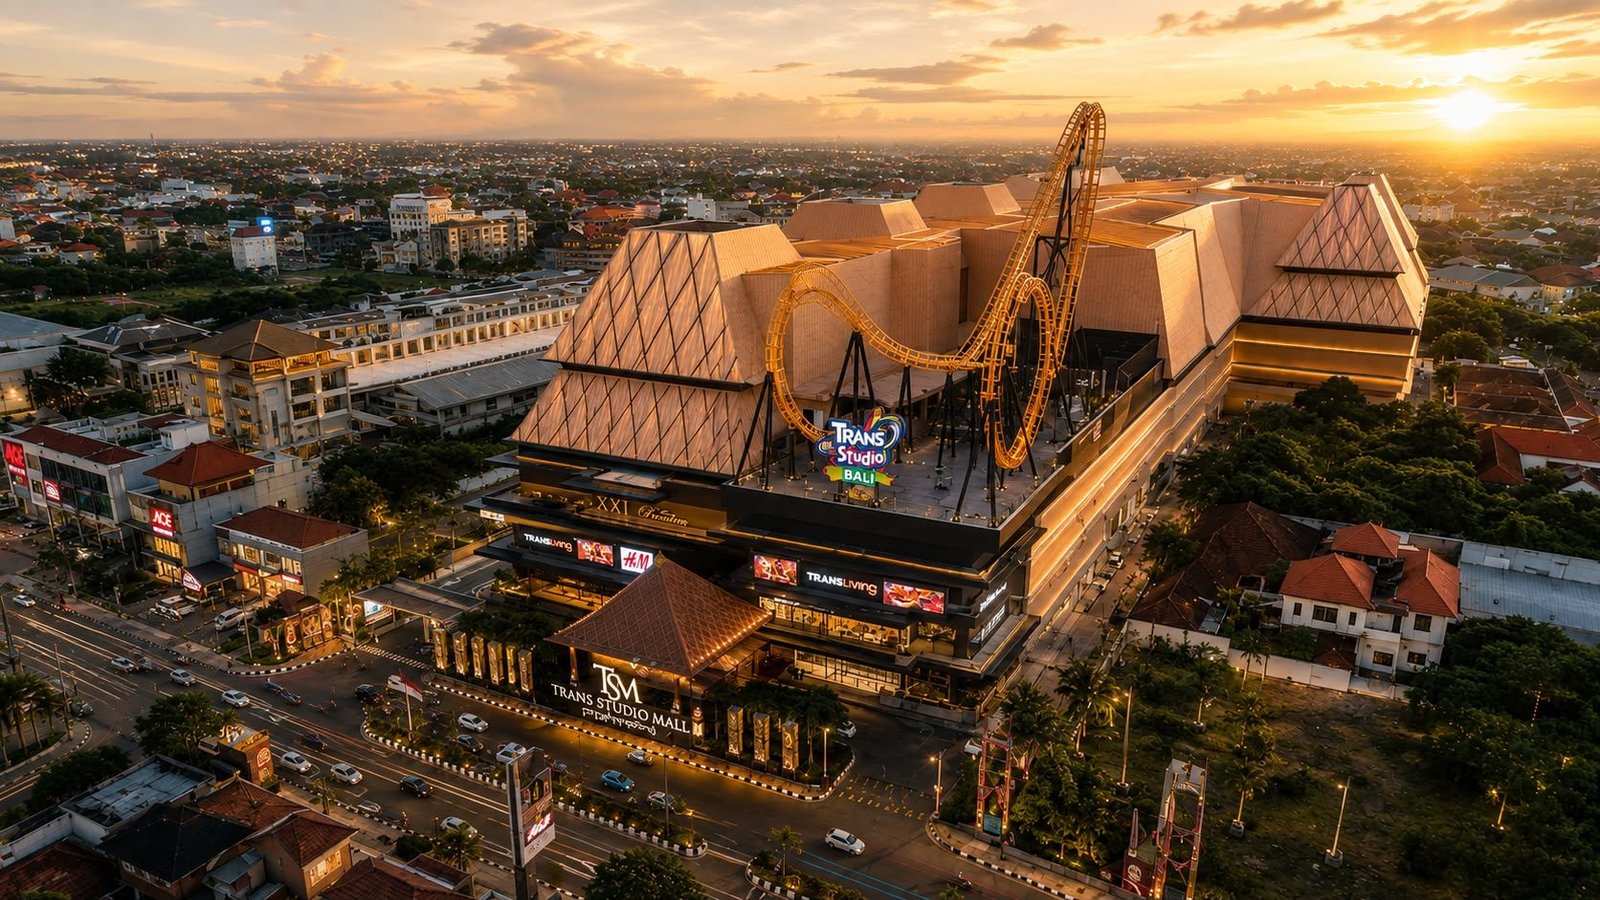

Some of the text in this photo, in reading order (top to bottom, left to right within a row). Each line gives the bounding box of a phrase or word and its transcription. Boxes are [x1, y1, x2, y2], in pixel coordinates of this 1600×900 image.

[832, 422, 885, 447] TRANS
[838, 446, 884, 466] Studio
[844, 469, 874, 484] BALI
[597, 495, 629, 515] XXI
[152, 511, 172, 528] ACE
[593, 663, 643, 704] TSM
[551, 683, 594, 706] TRANS
[597, 697, 649, 722] STUDIO
[652, 712, 690, 734] MALL
